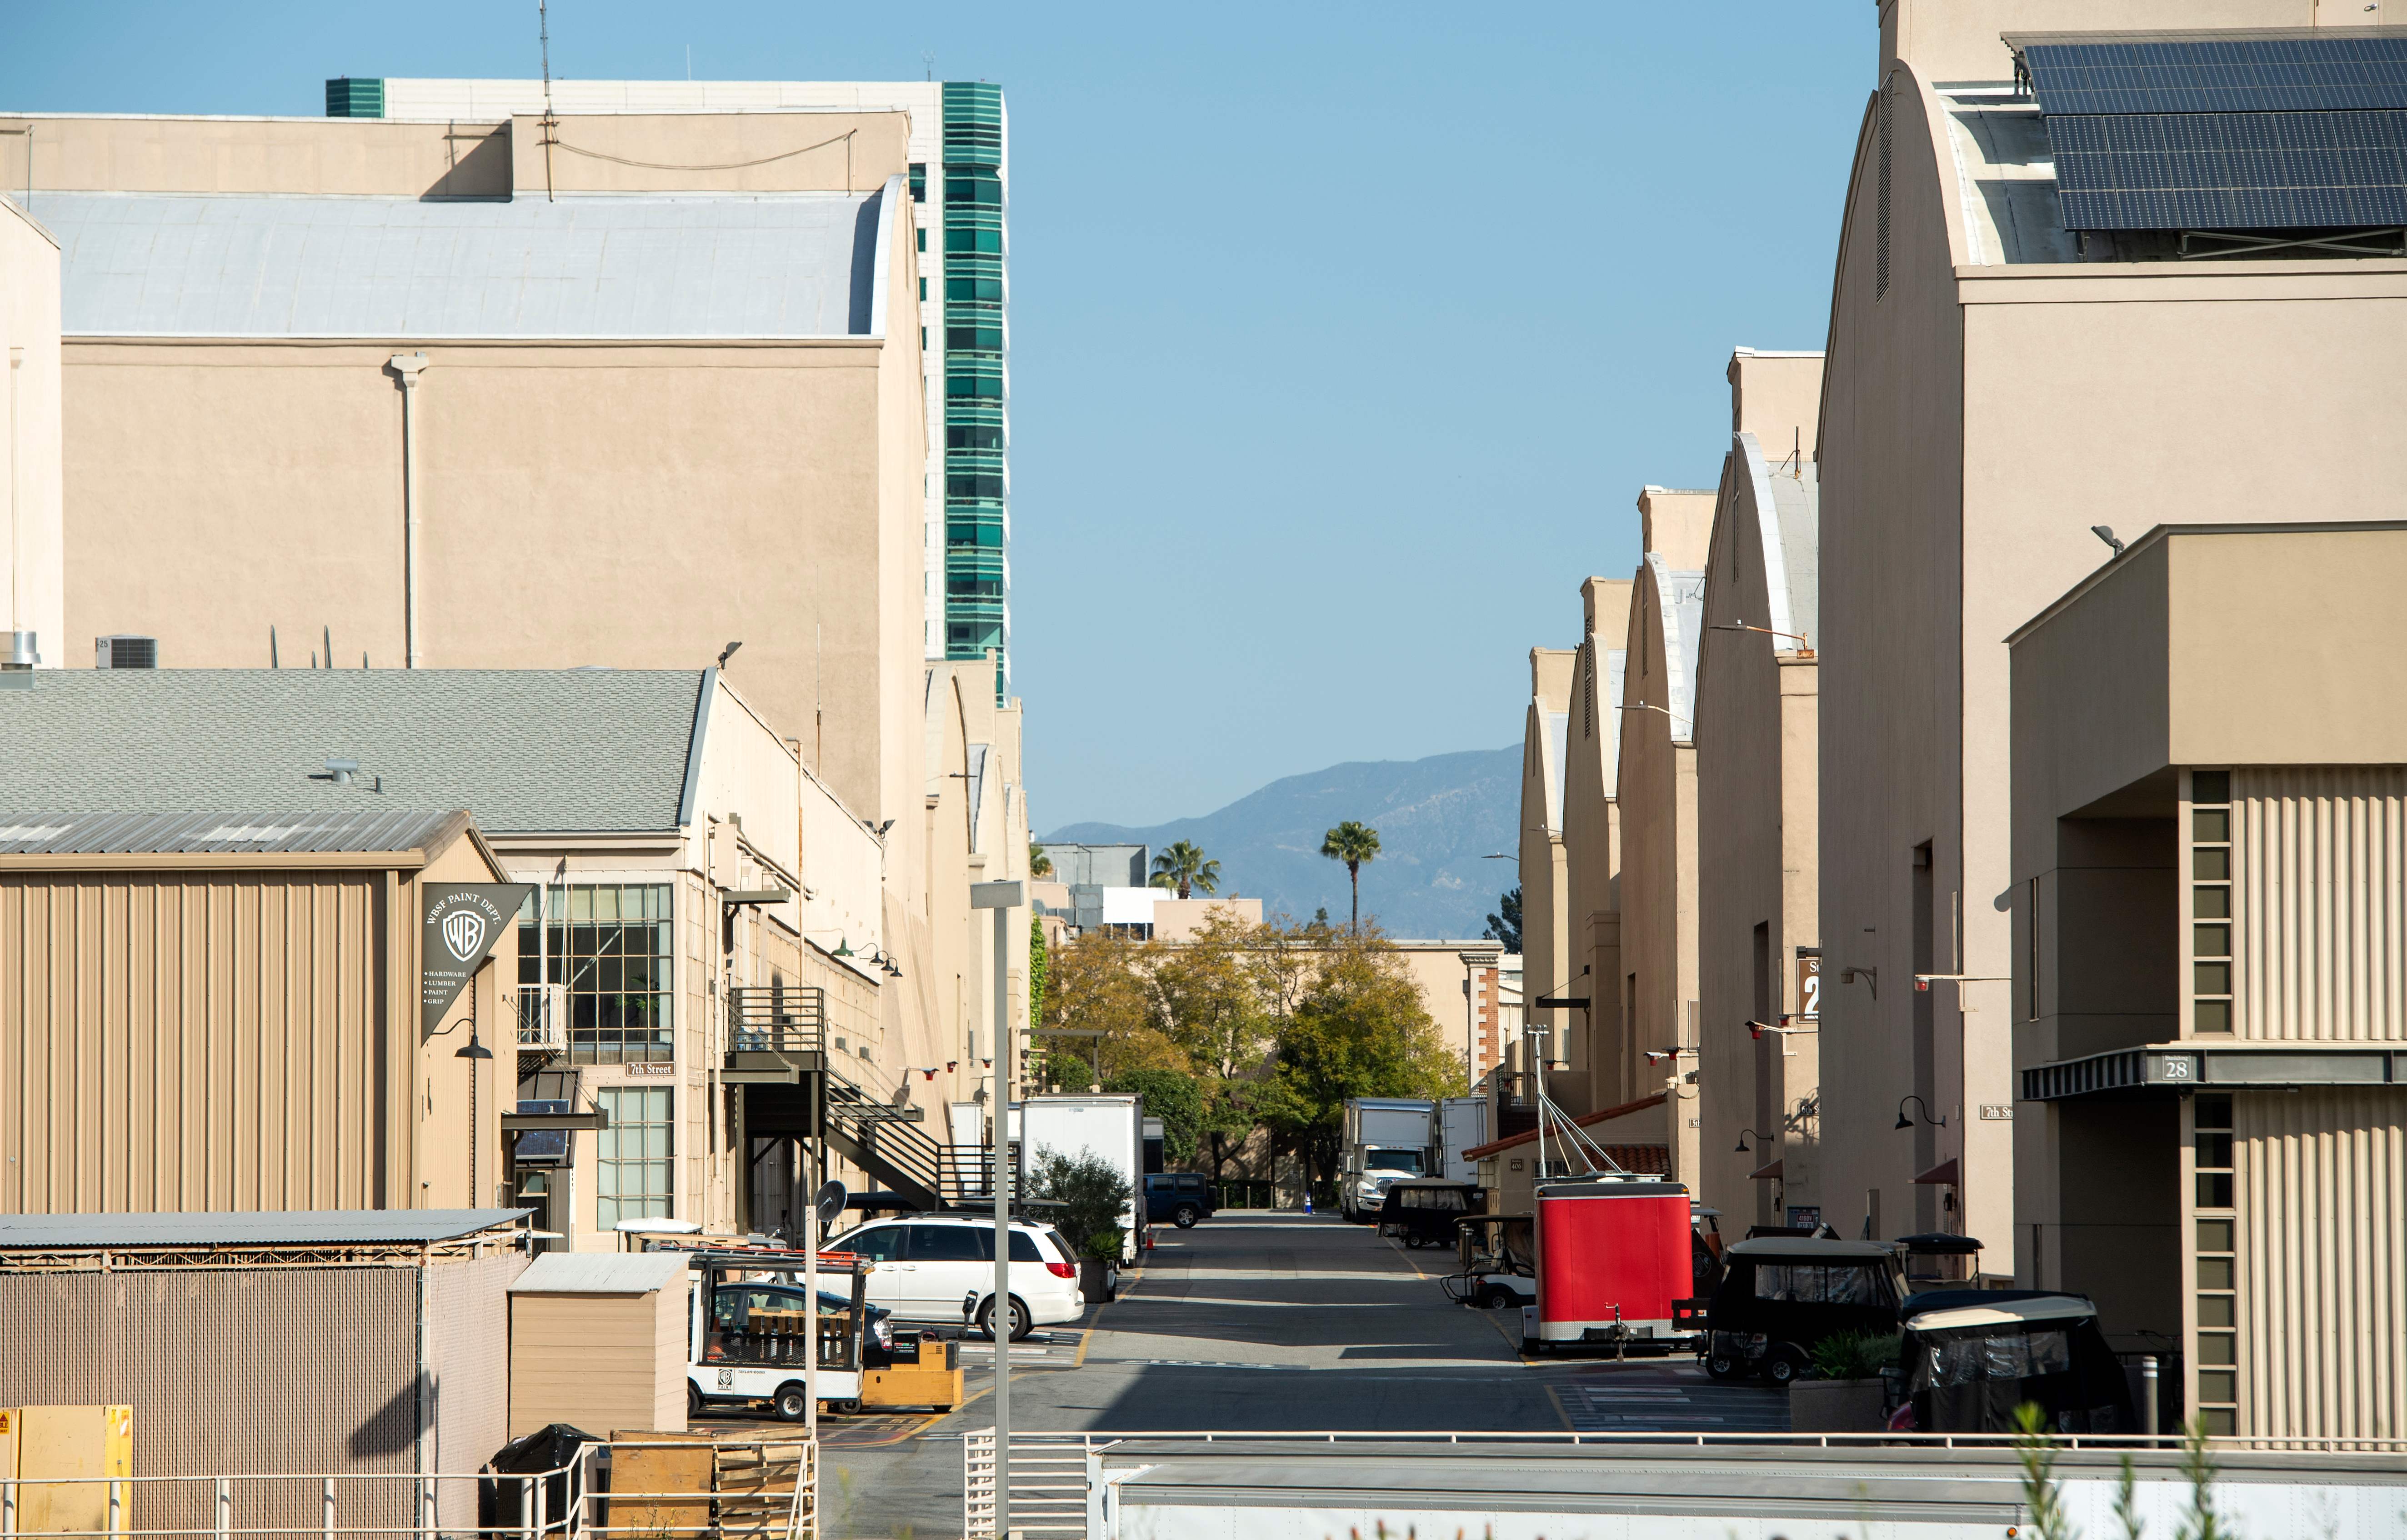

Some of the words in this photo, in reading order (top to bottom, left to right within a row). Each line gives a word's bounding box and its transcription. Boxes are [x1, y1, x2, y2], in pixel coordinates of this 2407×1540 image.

[427, 899, 446, 925] WBSF
[448, 892, 480, 904] PAINT
[480, 898, 502, 925] DEPT.
[448, 916, 480, 955] WB
[631, 1064, 644, 1075] 7th
[647, 1064, 671, 1074] Street
[2166, 1062, 2188, 1078] 28
[1986, 1107, 2000, 1117] 7th
